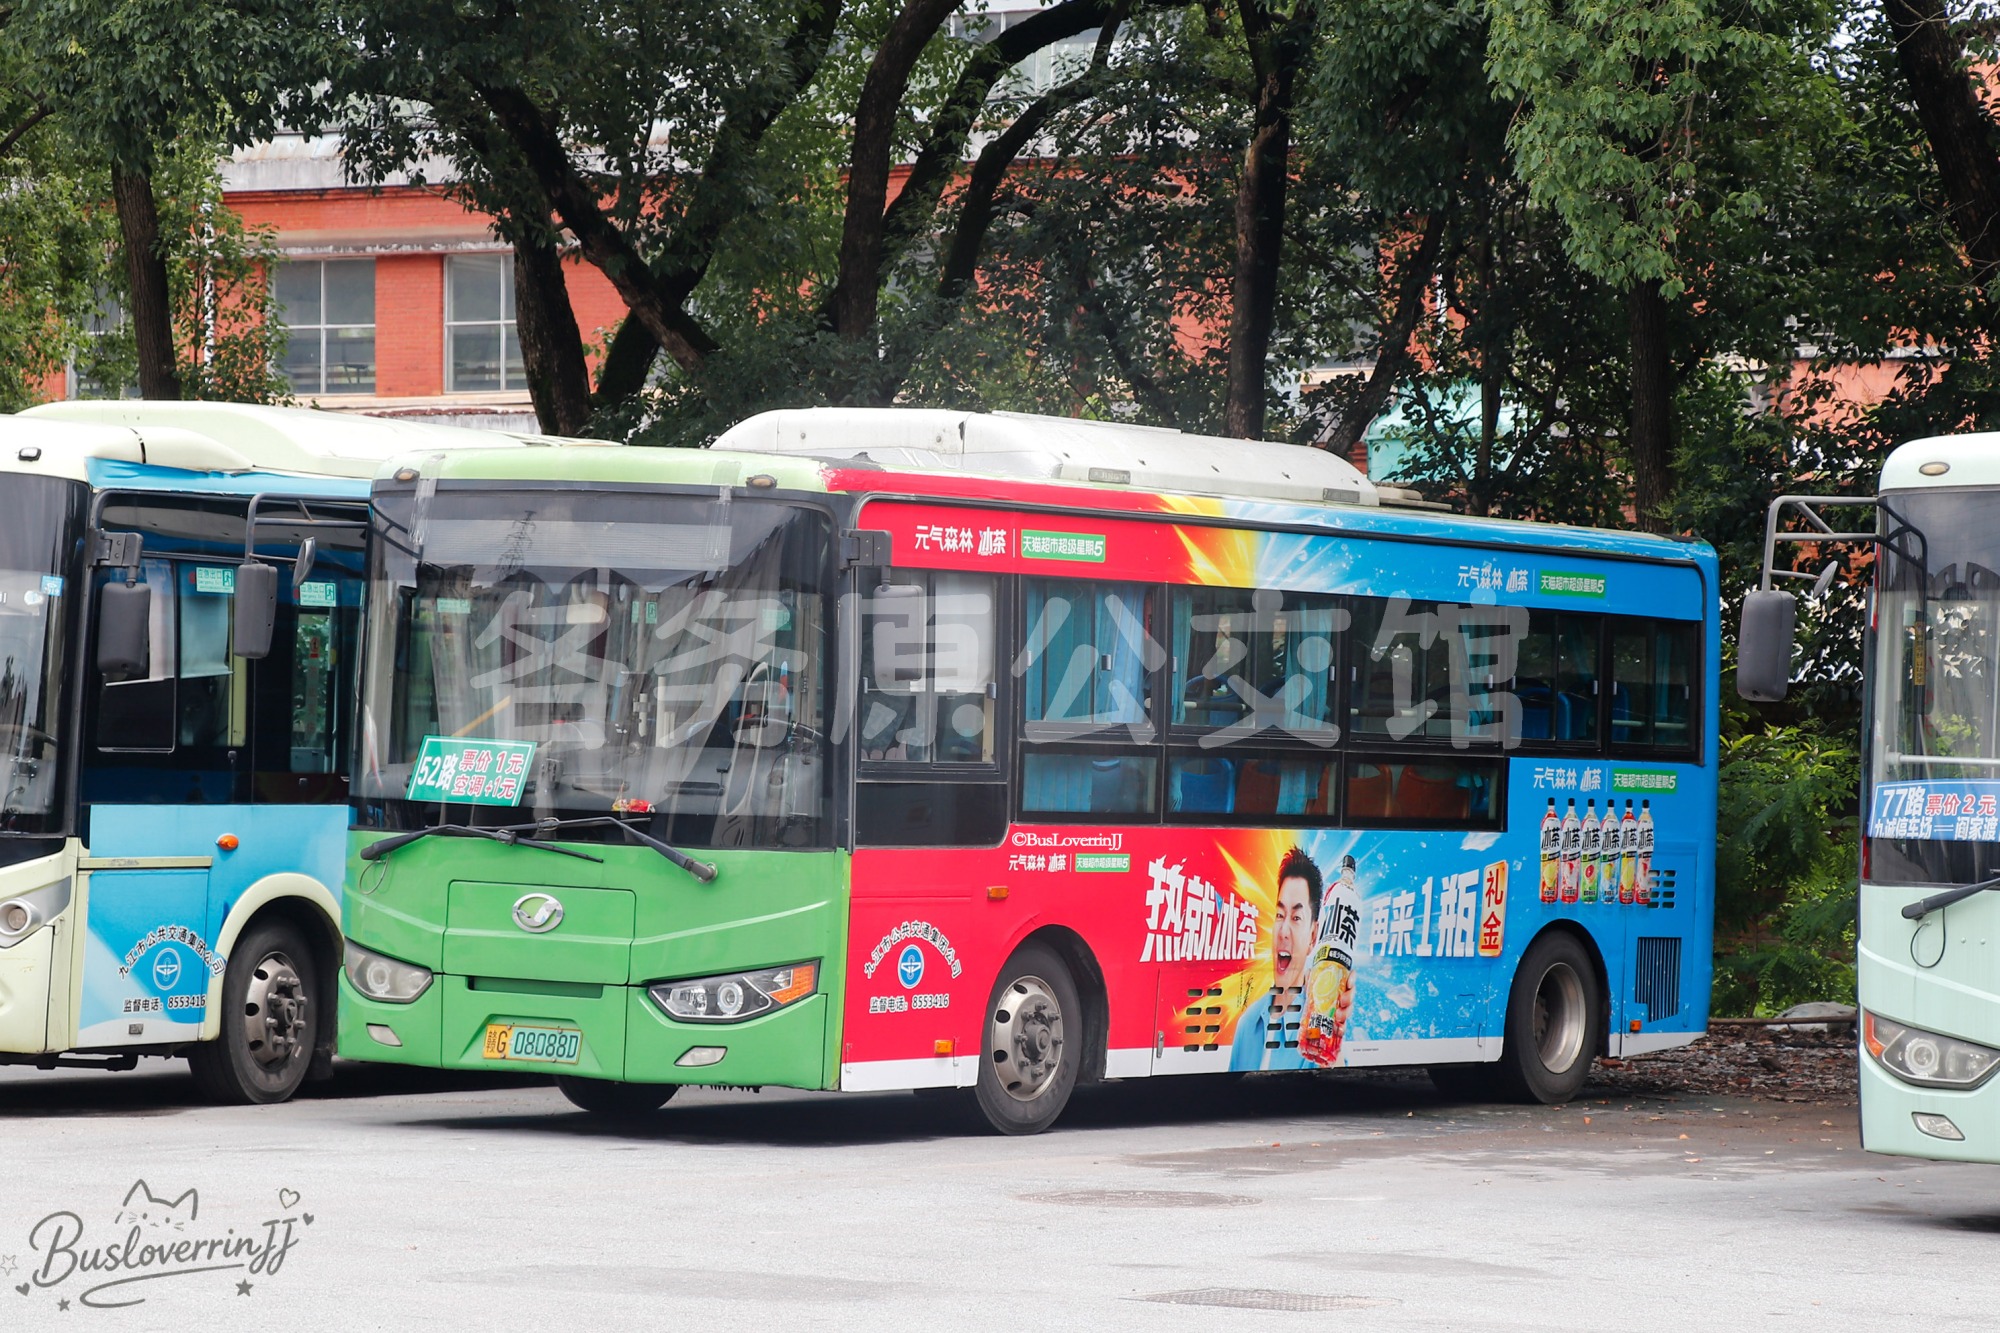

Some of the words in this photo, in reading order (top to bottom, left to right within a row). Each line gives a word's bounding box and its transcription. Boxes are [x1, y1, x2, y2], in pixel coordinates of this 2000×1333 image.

[915, 525, 974, 554] 元气森林
[978, 527, 1007, 556] 冰茶
[1022, 535, 1104, 557] 天猫超市超级星期5
[1457, 565, 1503, 591] 元气森林
[1506, 567, 1529, 593] 冰茶
[417, 753, 460, 791] 52路
[1533, 766, 1578, 791] 元气森林
[1580, 766, 1602, 793] 冰茶
[1882, 786, 1926, 818] 77路
[1008, 853, 1046, 872] 元气森林
[1139, 855, 1260, 963] 热就冰茶
[1319, 897, 1360, 950] 冰茶
[1369, 868, 1479, 957] 再来1瓶
[1481, 868, 1502, 950] 礼金
[119, 924, 226, 980] 九江市公共交通集团公司
[864, 920, 962, 979] 九江市公共交通集团公司
[168, 994, 207, 1009] 8553416
[912, 994, 949, 1009] 8553416
